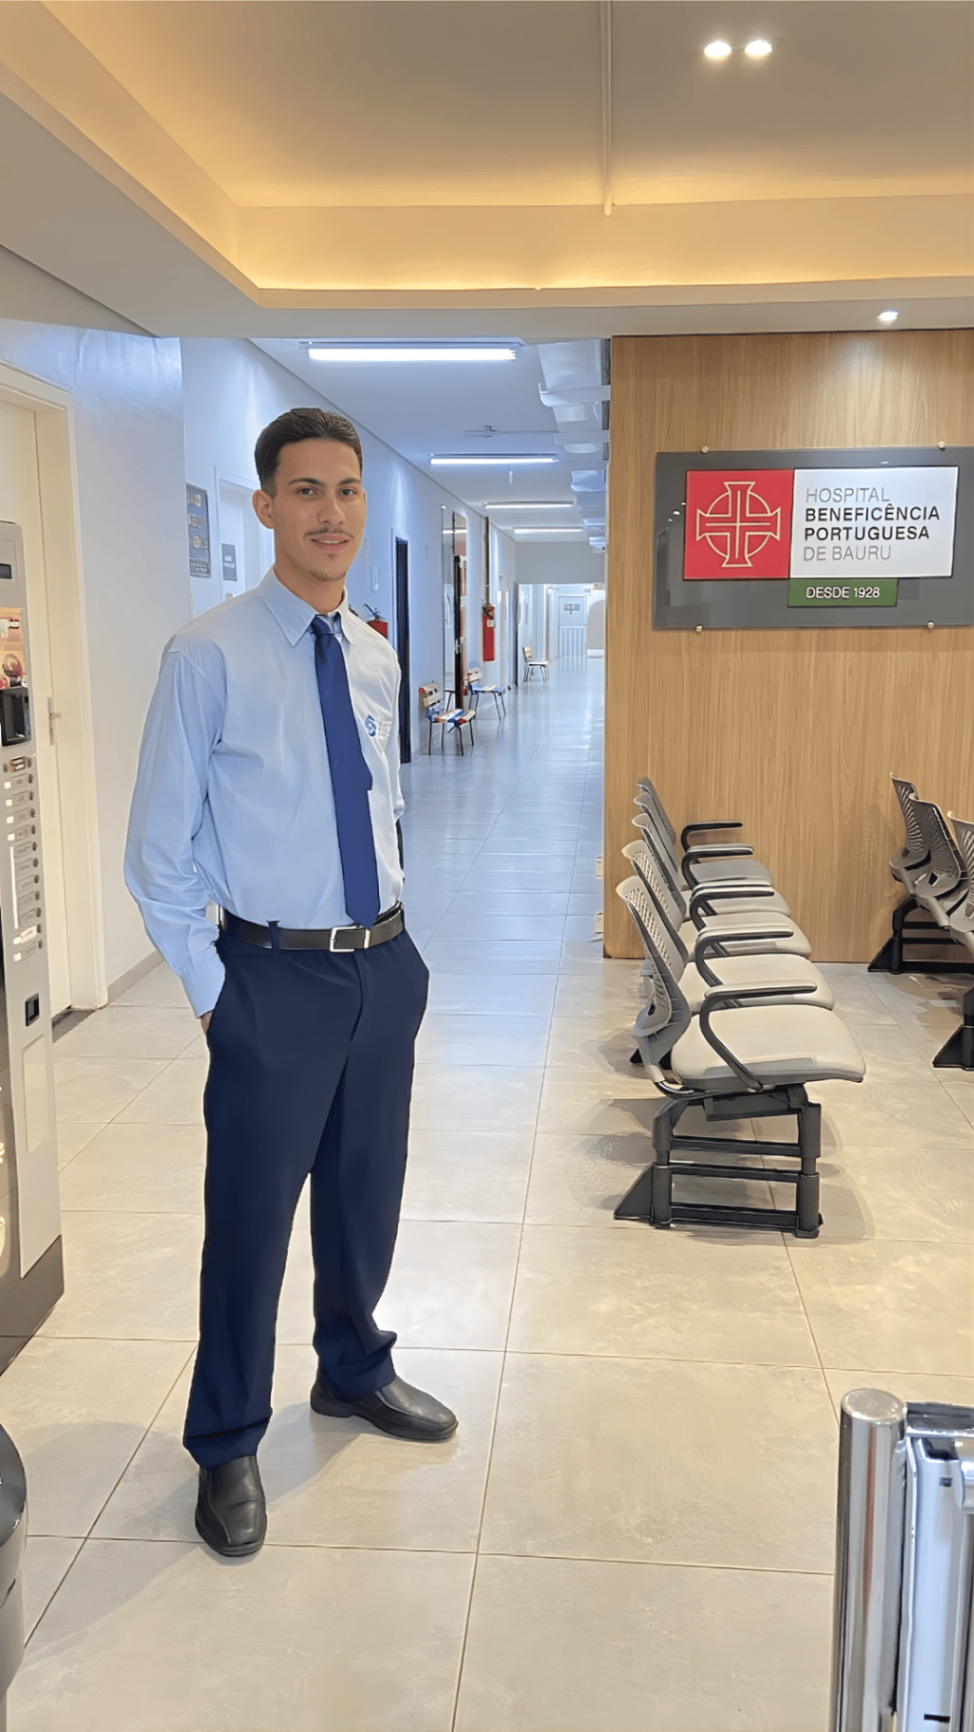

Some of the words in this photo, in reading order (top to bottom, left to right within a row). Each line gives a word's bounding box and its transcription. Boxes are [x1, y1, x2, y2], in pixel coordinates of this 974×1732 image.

[806, 487, 890, 503] HOSPITAL
[805, 503, 940, 522] BENEFICÊNCIA
[804, 526, 930, 541] PORTUGUESA
[803, 546, 826, 561] DE
[832, 545, 891, 561] BAURU
[806, 586, 850, 599] DESDE
[854, 586, 880, 599] 1928
